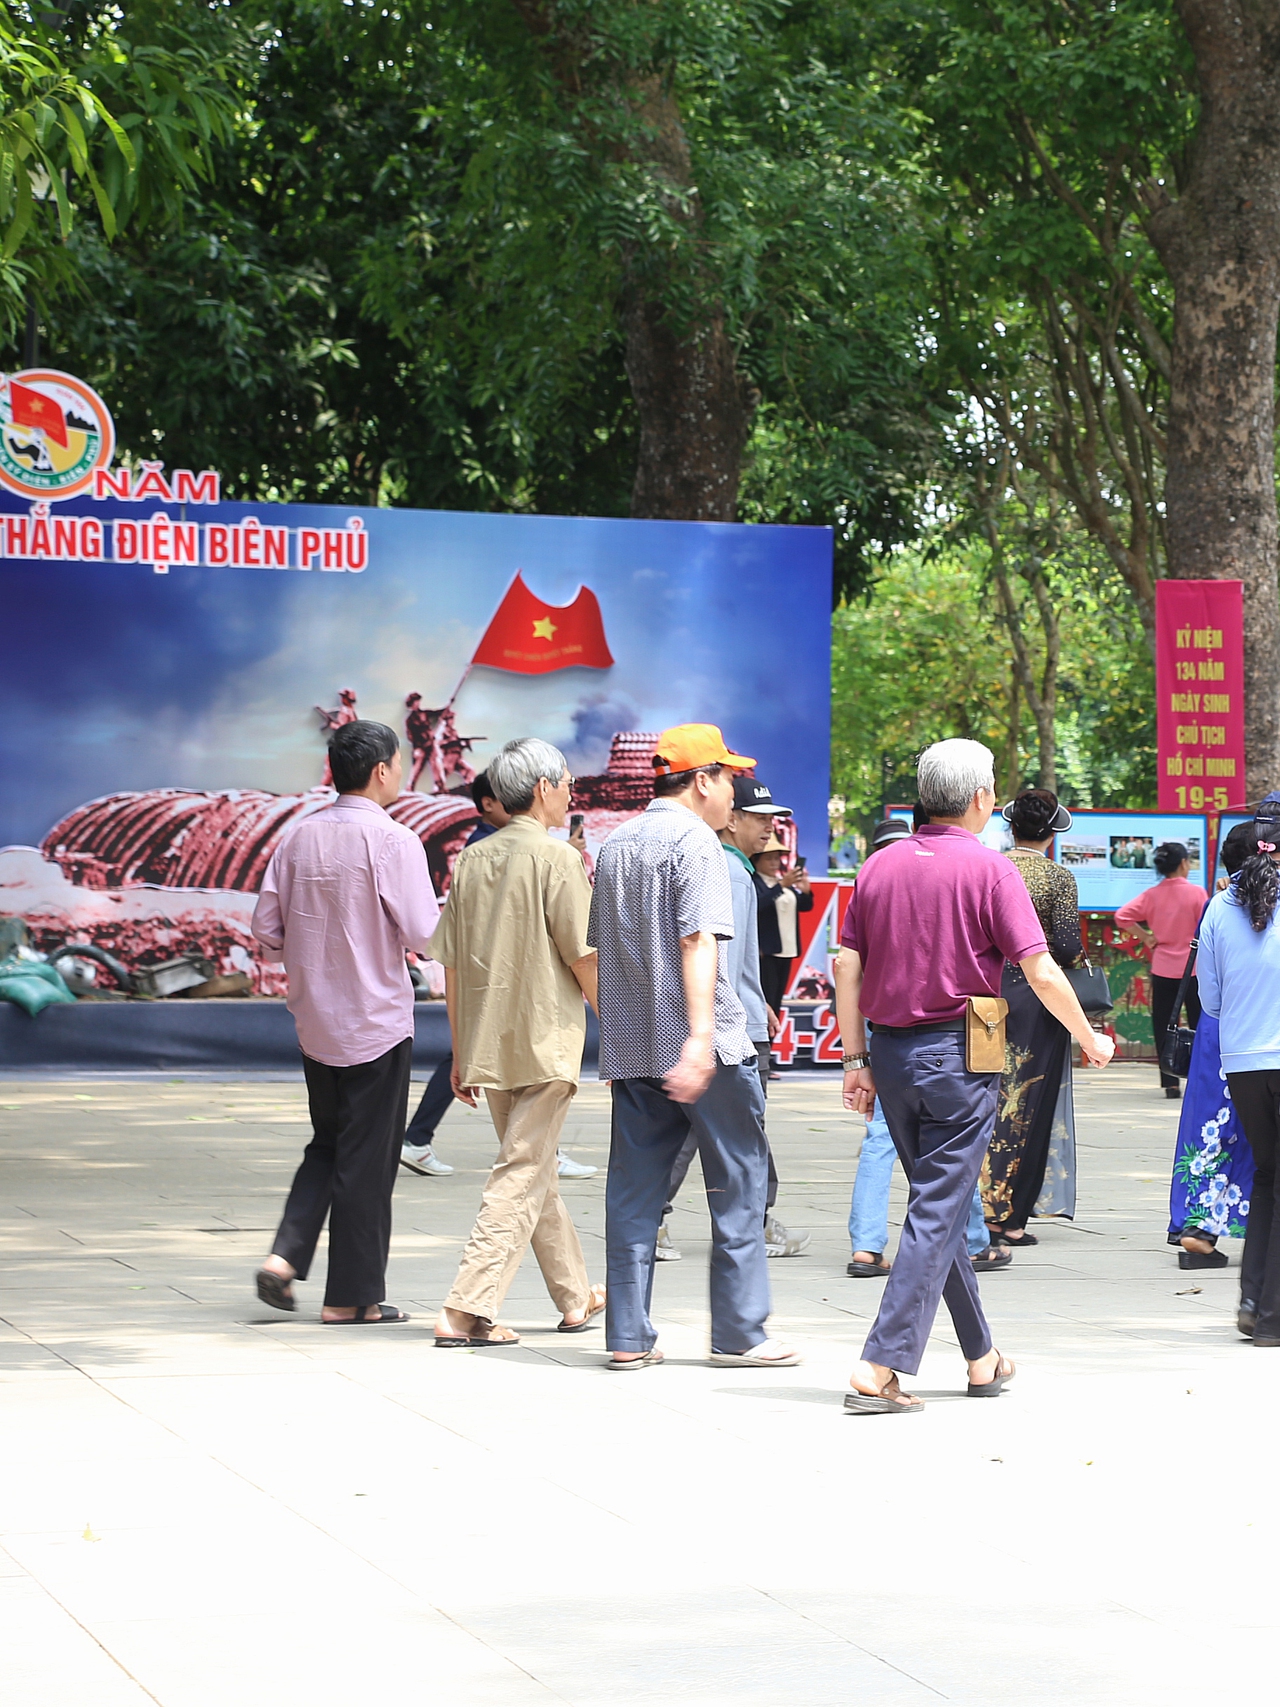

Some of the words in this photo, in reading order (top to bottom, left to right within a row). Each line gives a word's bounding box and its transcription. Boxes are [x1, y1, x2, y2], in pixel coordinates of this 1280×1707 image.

[95, 461, 218, 503] NĂM
[116, 515, 196, 571] ĐIỆN
[209, 519, 286, 566] BIÊN
[301, 518, 367, 570] PHỦ
[1193, 625, 1223, 653] NIỆM
[1176, 661, 1197, 681] 134
[1198, 658, 1225, 681] NĂM
[1171, 690, 1200, 713] NGÀY
[1203, 694, 1230, 713] SINH
[1176, 720, 1199, 745] CHỦ
[1200, 726, 1226, 749] TỊCH
[1185, 755, 1204, 777] CHÍ
[1206, 757, 1236, 777] MINH
[1174, 785, 1229, 810] 19-5
